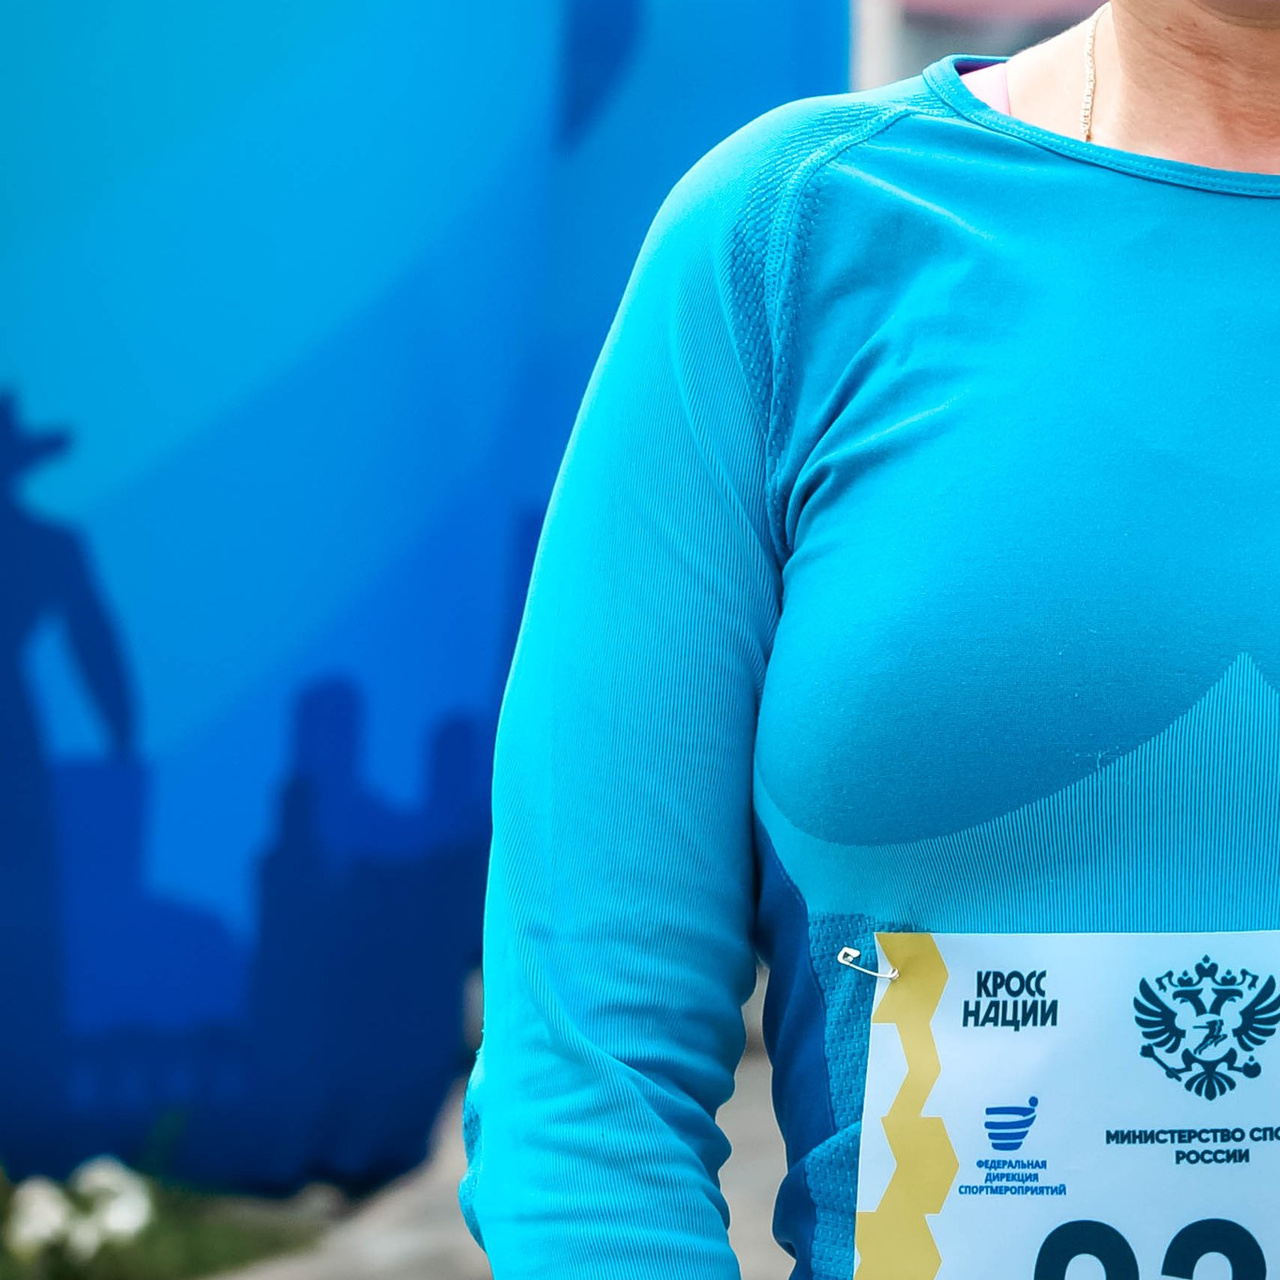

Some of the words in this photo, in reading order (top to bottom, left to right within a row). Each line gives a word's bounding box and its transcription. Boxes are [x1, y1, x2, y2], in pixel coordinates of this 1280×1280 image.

[977, 970, 1047, 998] КРОСС
[962, 999, 1058, 1032] НАЦИИ
[1105, 1128, 1246, 1145] МИНИСТЕРСТВО
[976, 1159, 1048, 1171] ФЕДЕРАЛЬНАЯ
[1175, 1148, 1250, 1165] РОССИИ
[984, 1173, 1039, 1184] ДИРЕКЦИЯ
[958, 1183, 1067, 1195] СПОРТМЕРОПРИЯТИЙ
